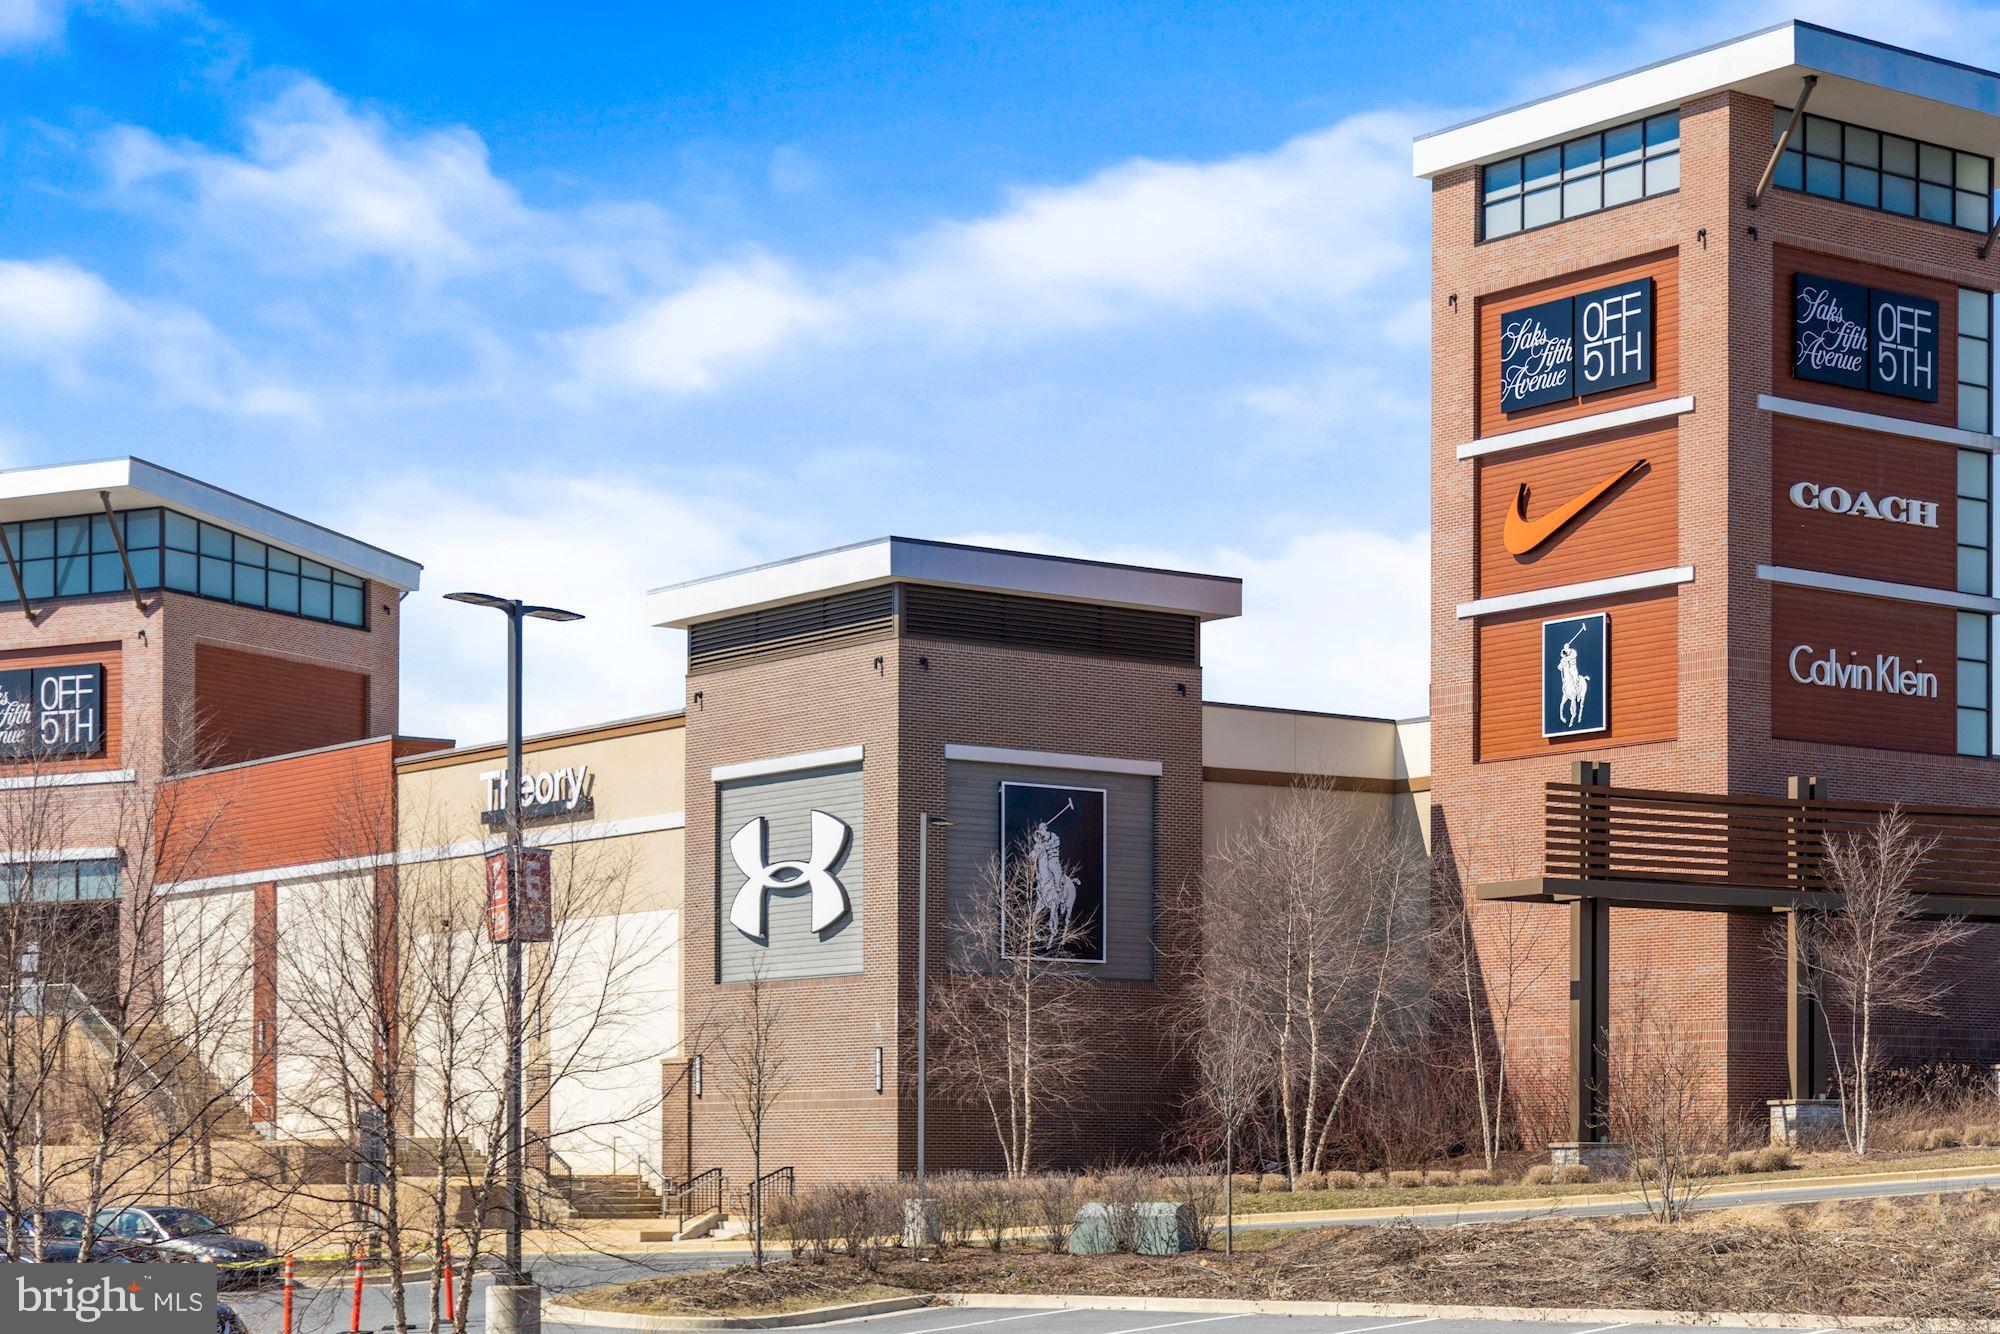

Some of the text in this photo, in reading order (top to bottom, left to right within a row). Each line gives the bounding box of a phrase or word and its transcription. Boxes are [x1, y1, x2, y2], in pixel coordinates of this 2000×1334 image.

[1583, 291, 1642, 342] OFF
[1797, 286, 1843, 324] Saks
[1878, 302, 1932, 348] OFF
[1501, 318, 1547, 362] Saks
[1583, 331, 1642, 382] 5TH
[1797, 330, 1862, 370] Avenue
[1501, 365, 1567, 403] Avenue
[1878, 341, 1932, 390] 5TH
[1789, 481, 1940, 529] COACH
[40, 674, 94, 711] OFF
[1789, 644, 1938, 699] Calvin Klein
[40, 708, 94, 745] 5TH
